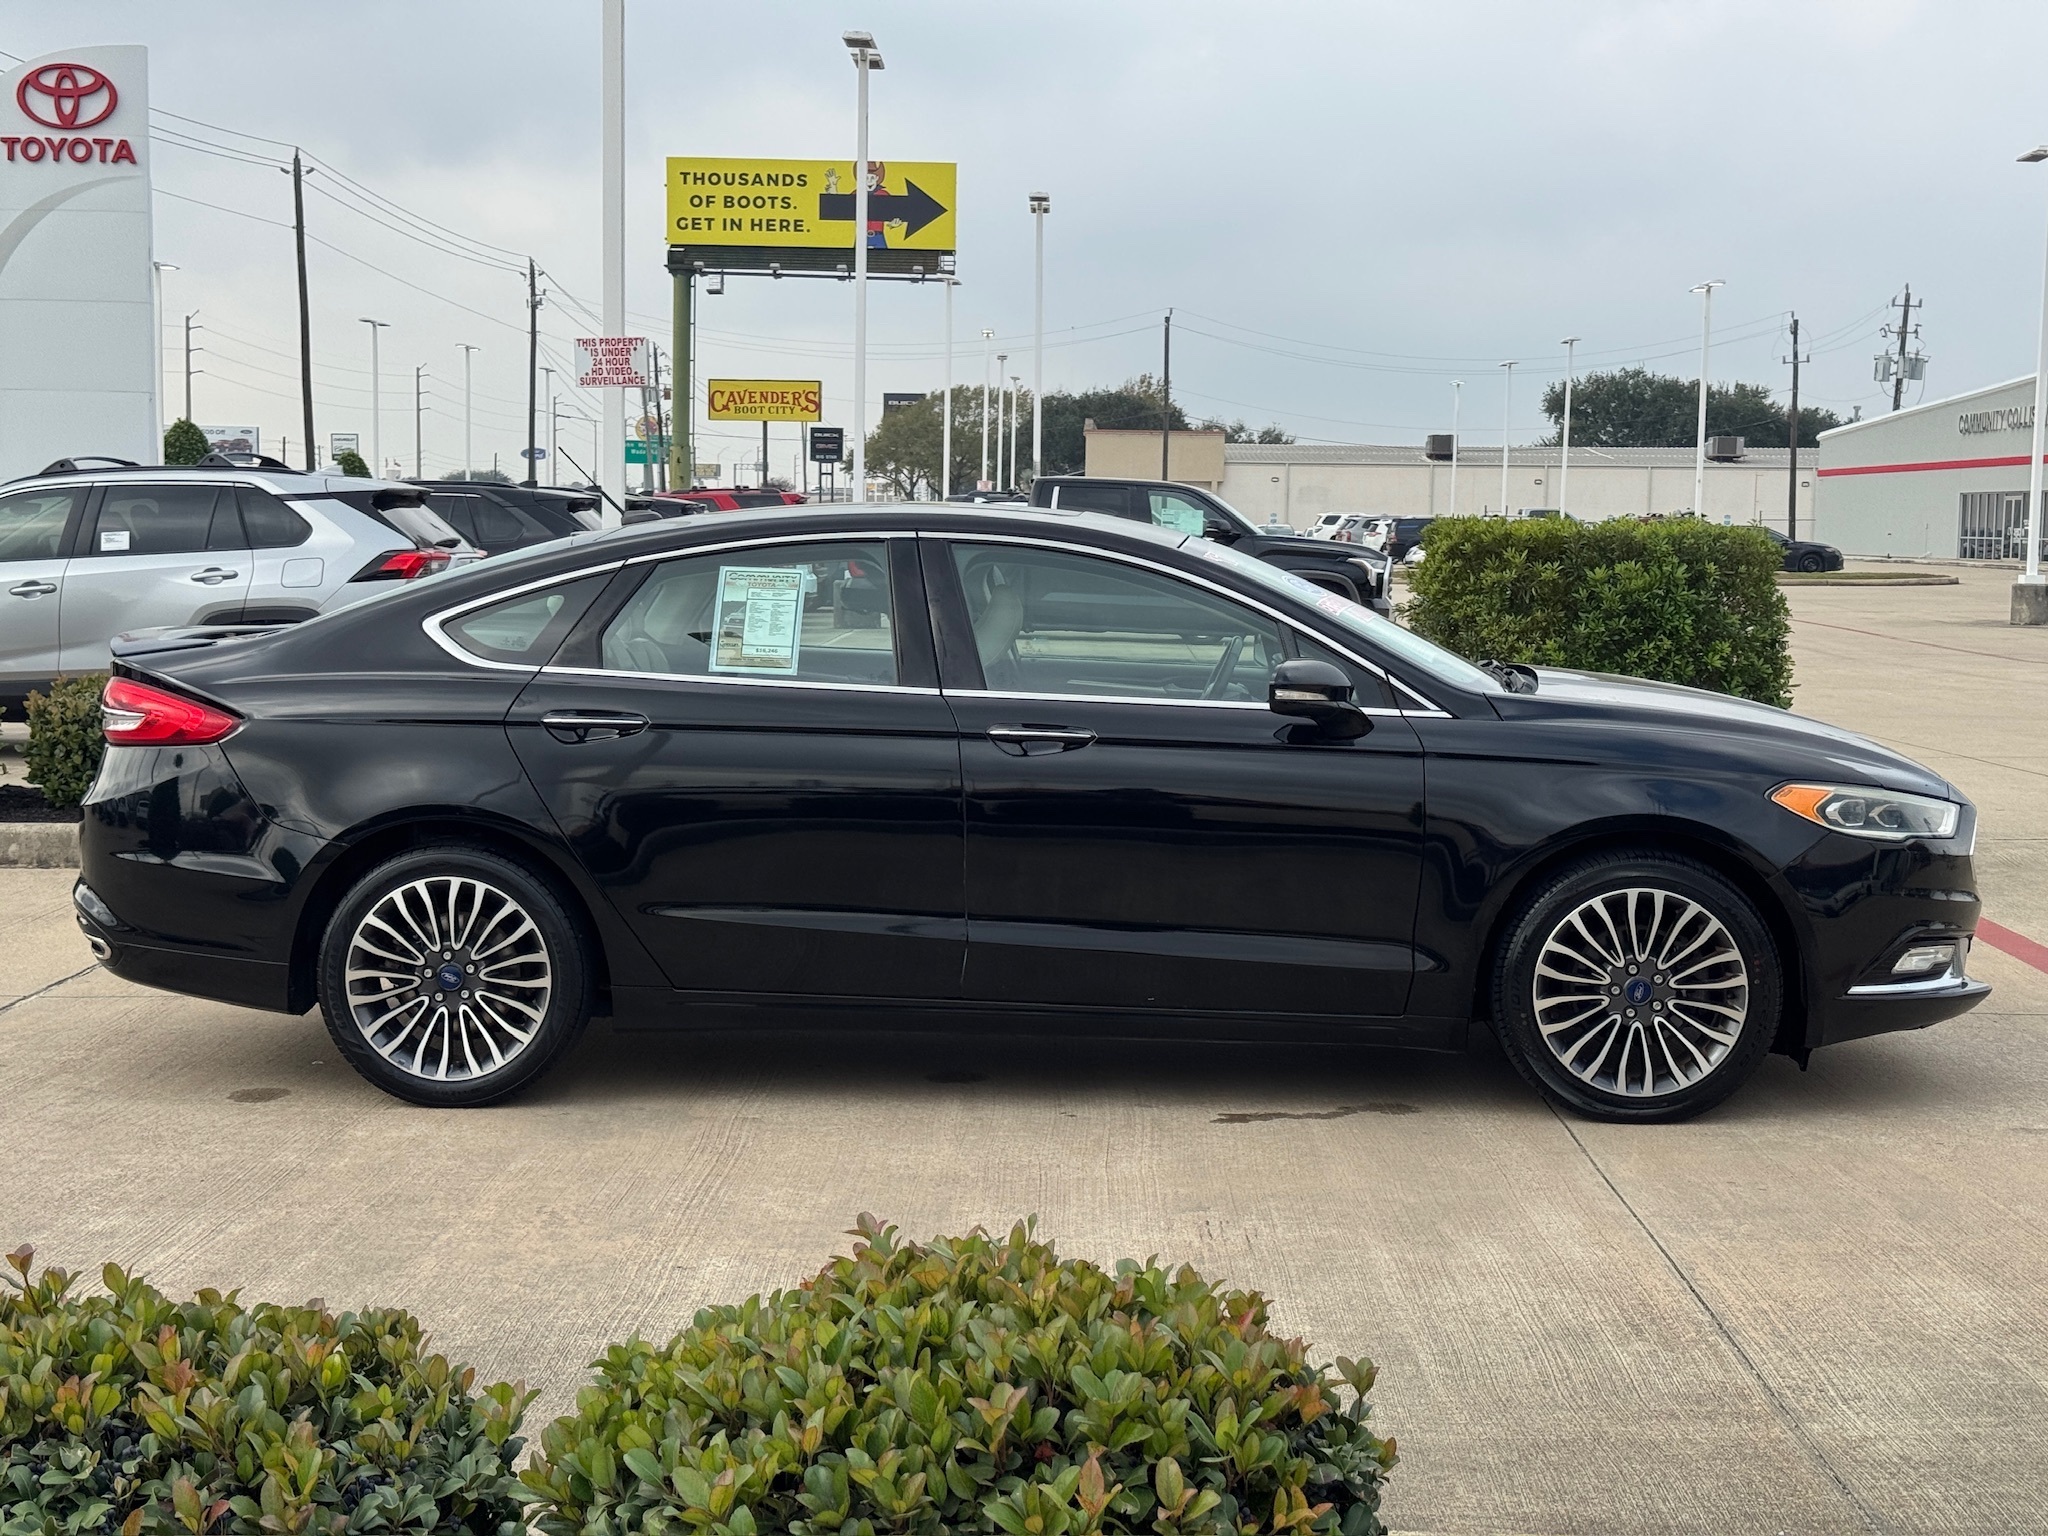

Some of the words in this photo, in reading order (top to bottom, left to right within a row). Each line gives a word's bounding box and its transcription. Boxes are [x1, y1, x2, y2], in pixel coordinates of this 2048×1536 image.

[0, 137, 137, 164] TOYOTA
[679, 171, 808, 187] THOUSANDS
[689, 195, 716, 208] OF
[723, 195, 798, 210] BOOTS.
[676, 217, 716, 231] GET
[722, 217, 743, 232] IN
[750, 218, 811, 233] HERE.
[576, 338, 597, 347] THIS
[600, 337, 646, 347] PROPERTY
[590, 347, 599, 357] IS
[602, 347, 632, 357] UNDER
[593, 357, 603, 366] 24
[605, 357, 631, 366] HOUR
[591, 367, 604, 376] HD
[606, 366, 633, 376] VIDEO
[579, 376, 646, 386] SURVEILLANCE
[710, 388, 820, 414] CAVENDER'S
[734, 405, 766, 415] BOOT
[768, 405, 796, 415] CITY
[1958, 409, 2006, 435] COMMUNITY
[2007, 405, 2035, 430] COLLIS
